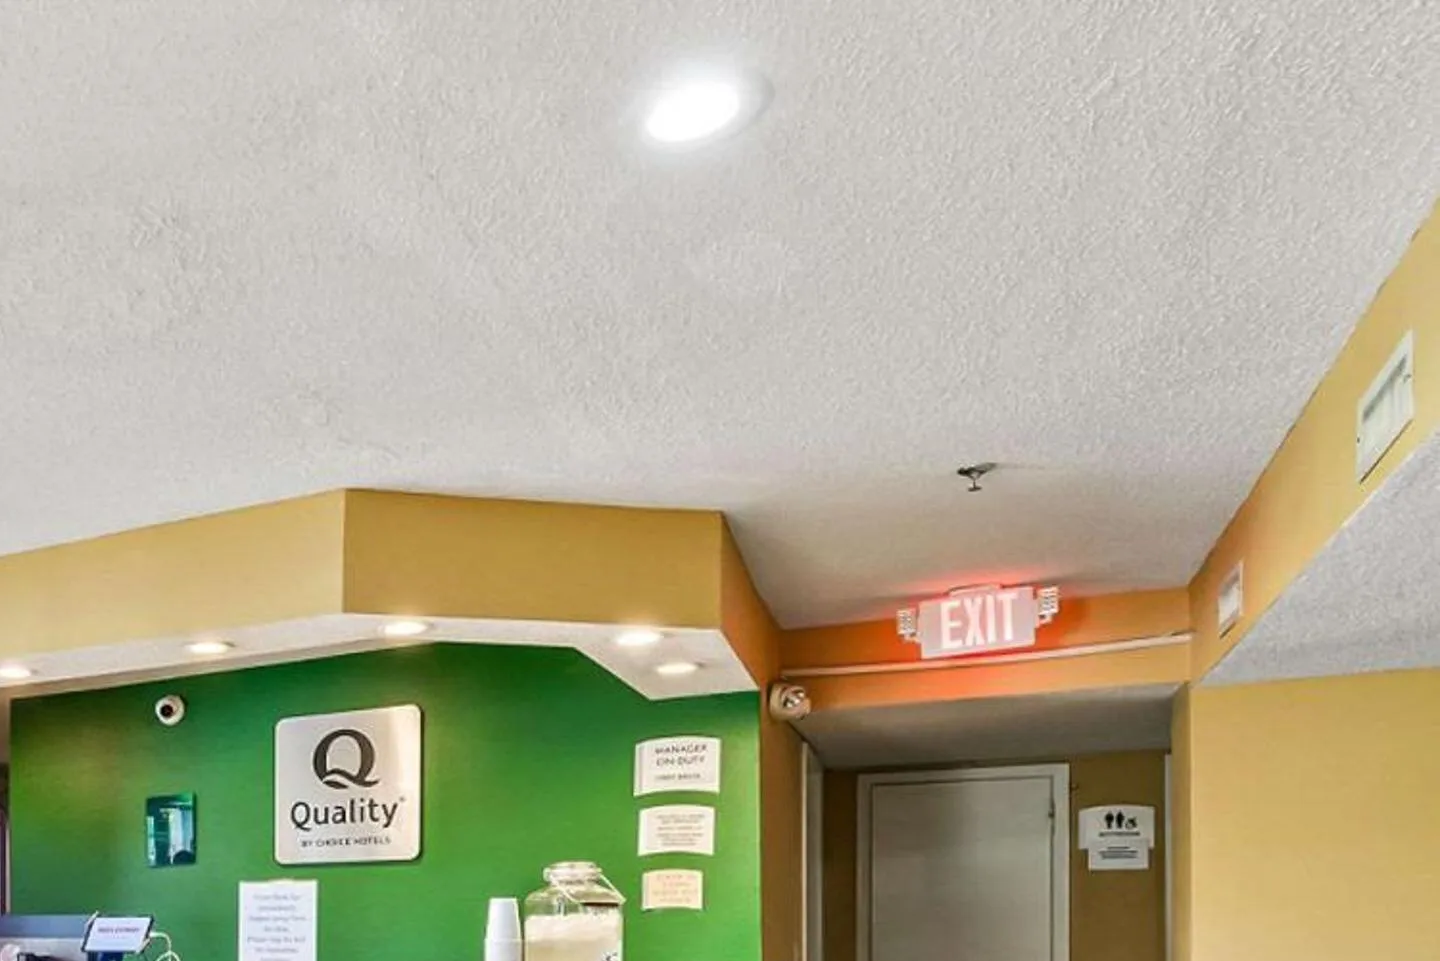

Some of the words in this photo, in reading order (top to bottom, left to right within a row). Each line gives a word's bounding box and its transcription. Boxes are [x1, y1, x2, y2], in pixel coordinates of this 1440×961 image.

[940, 592, 1019, 650] EXIT
[290, 798, 399, 832] Quality
[353, 836, 391, 846] HOTELS
